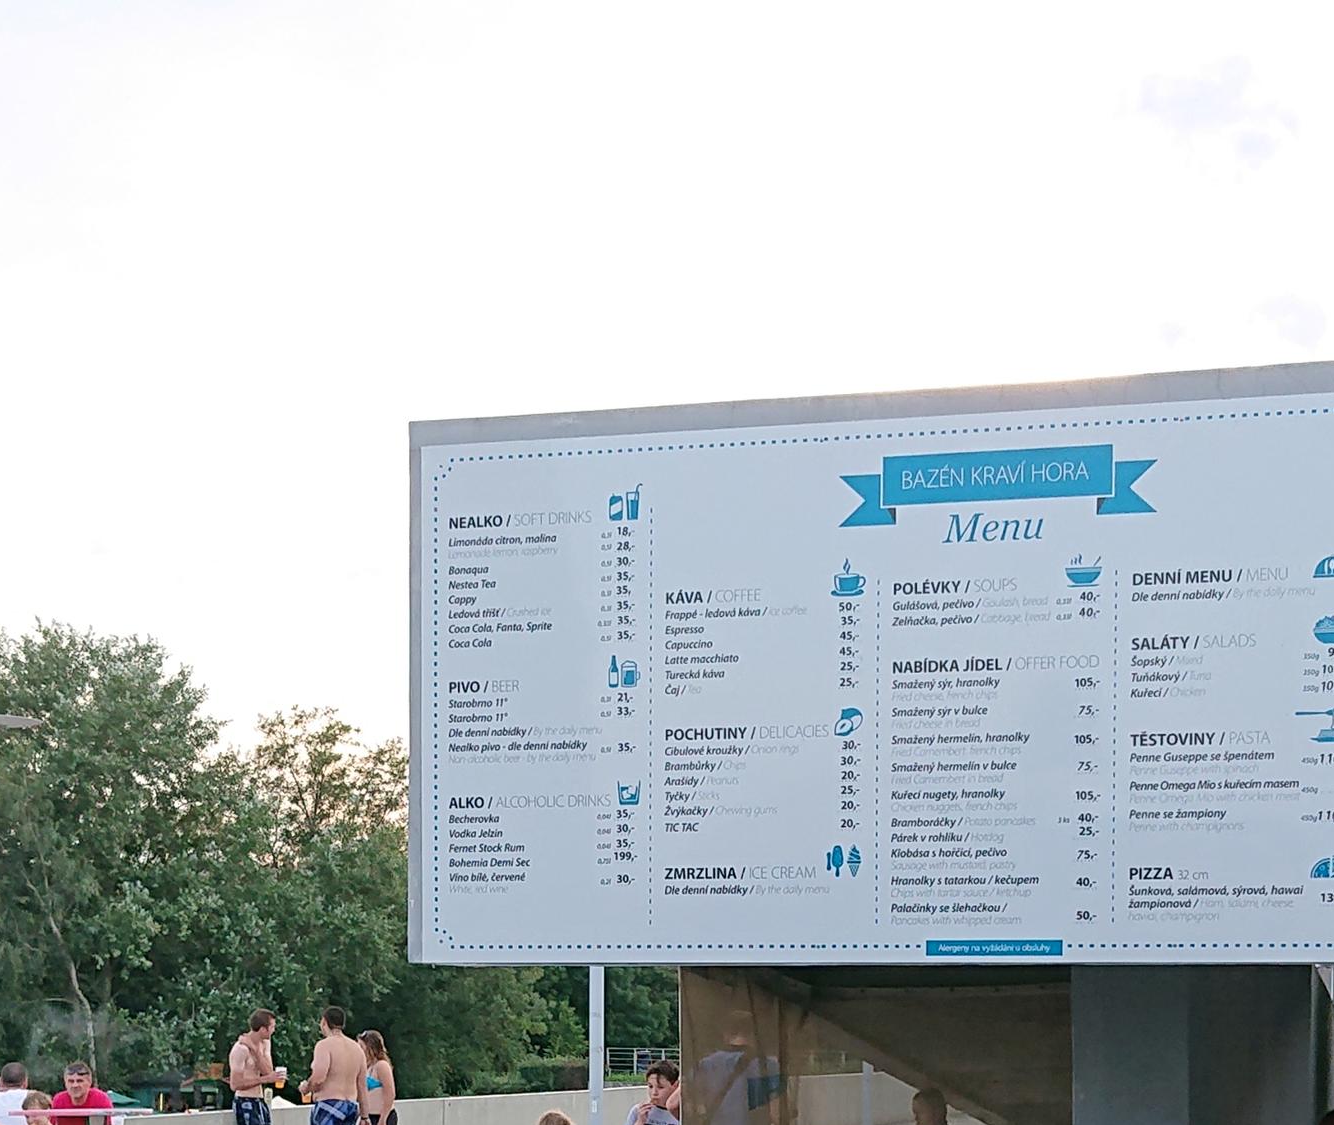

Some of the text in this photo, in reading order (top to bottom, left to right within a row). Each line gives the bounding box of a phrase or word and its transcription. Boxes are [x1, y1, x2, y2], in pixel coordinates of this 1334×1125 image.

[902, 460, 1089, 490] BAZÉN KRAVÍ HORA
[449, 511, 592, 529] NEALKO SOFT DRINKS
[943, 513, 1044, 543] Menu
[449, 534, 556, 547] Limonáda citron, malina
[449, 565, 488, 576] Bonaqua
[1133, 568, 1288, 586] DENNÍ MENU MENU
[449, 580, 496, 589] Nestea Tea
[894, 578, 1017, 595] POLÉVKY SOUPS
[449, 595, 476, 605] Cappy
[666, 589, 761, 604] KÁVA COFFEE
[943, 600, 974, 610] pečivo
[449, 621, 552, 634] Coca Cola, Fanta, Sprite
[665, 626, 704, 635] Espresso
[665, 640, 712, 651] Capuccino
[1132, 634, 1257, 650] SALÁTY SALADS
[665, 654, 739, 665] Latte macchiato
[893, 655, 1100, 674] NABÍDKA JÍDEL OFFER FOOD
[666, 669, 724, 679] Turecká káva
[1132, 671, 1180, 683] Tuňákový
[449, 680, 519, 693] PIVO BEER
[892, 678, 1000, 691] Smažený sýr, hranolky
[892, 707, 936, 718] Smažený
[937, 708, 952, 717] sýr
[963, 706, 988, 715] bulce
[666, 725, 829, 741] POCHUTINY DELICACIES
[1131, 731, 1270, 746] TĚSTOVINY PASTA
[665, 745, 743, 756] Cibulové kroužky
[449, 794, 611, 809] ALKO ALCOHOLIC DRINKS
[449, 814, 499, 823] Becherovka
[1129, 808, 1226, 821] Penne se žampiony
[449, 828, 503, 838] Vodka Jelzin
[665, 823, 699, 832] TIC TAC
[449, 858, 530, 868] Bohemia Demi Sec
[665, 866, 816, 880] ZMRZLINA ICE CREAM
[1129, 867, 1208, 880] PIZZA 32 cm
[1129, 885, 1174, 896] Šunková,
[1177, 884, 1229, 895] salámová,
[1232, 885, 1268, 896] sýrová,
